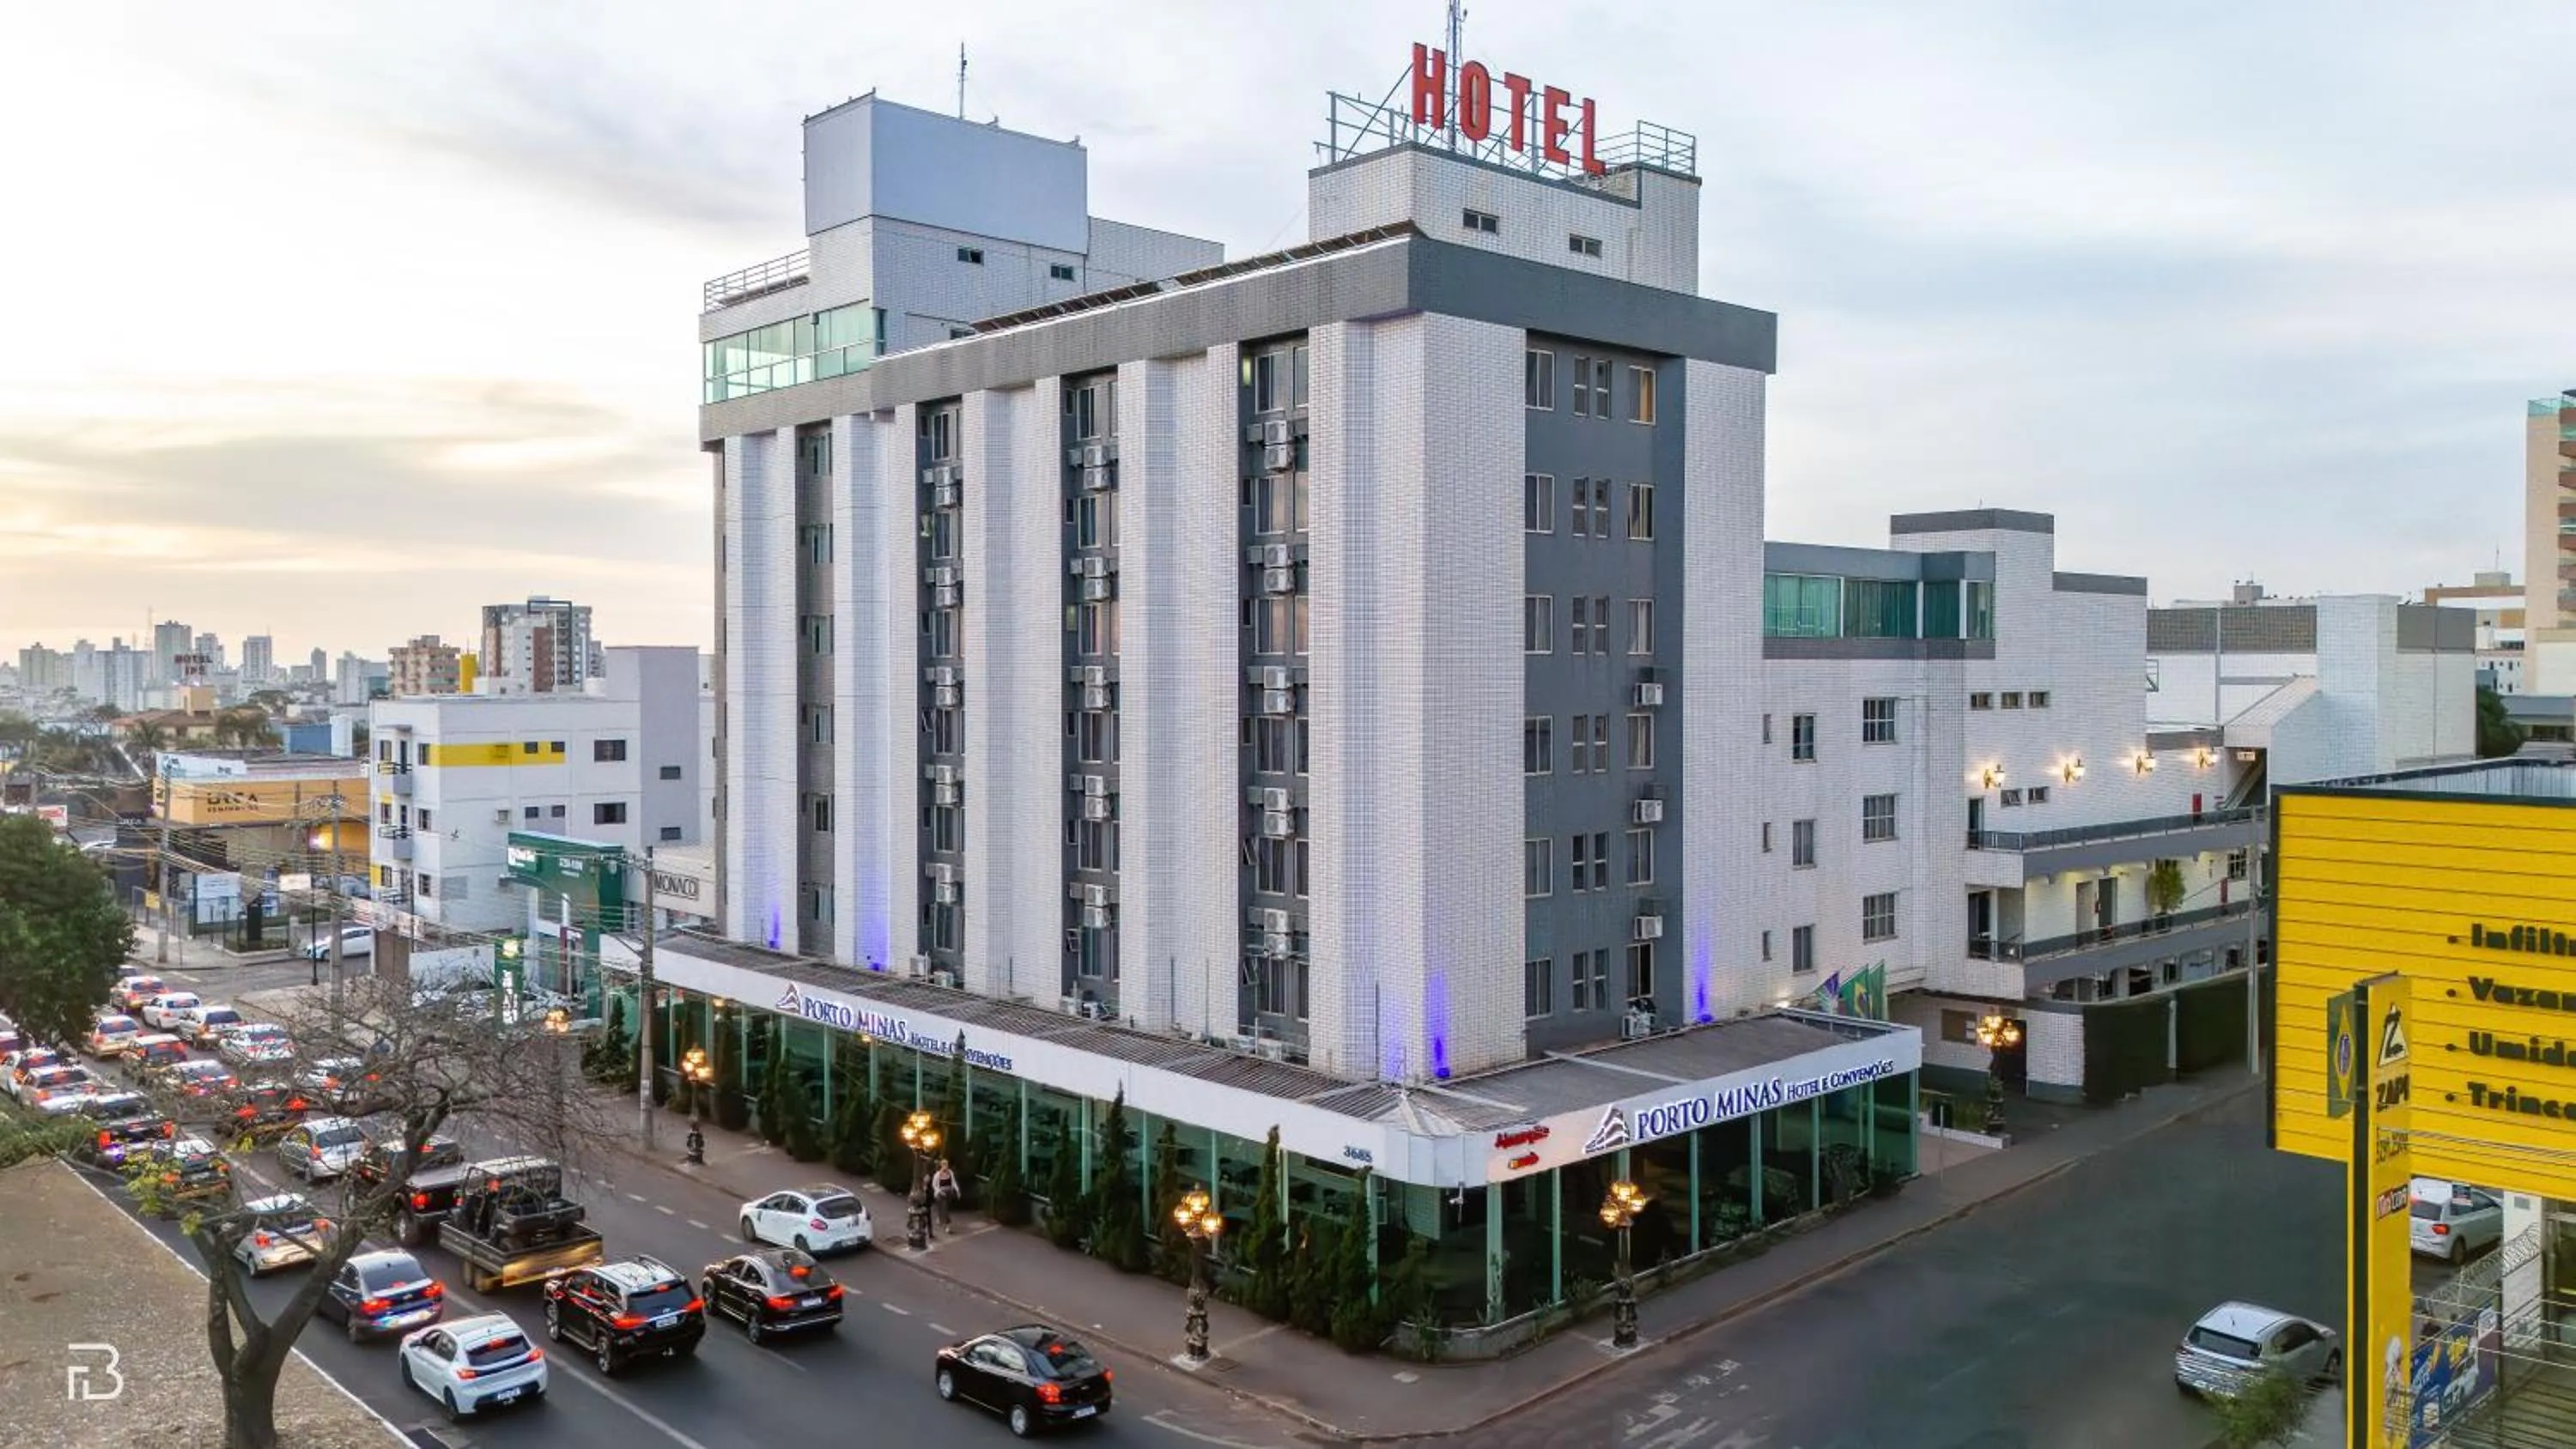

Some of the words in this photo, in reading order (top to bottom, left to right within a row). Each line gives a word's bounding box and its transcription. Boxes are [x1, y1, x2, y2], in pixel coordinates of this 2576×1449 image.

[1411, 41, 1606, 177] HOTEL
[805, 997, 851, 1028] PORTO
[858, 1009, 907, 1042] MINAS
[911, 1031, 939, 1052] HOTEL
[949, 1043, 1012, 1070] CNVENÇÕES
[1637, 1097, 1709, 1140] PORTO
[1715, 1078, 1781, 1119] MINAS
[1785, 1079, 1819, 1099] HOTEL
[1821, 1076, 1828, 1090] E
[1830, 1059, 1893, 1088] CONVENÇÕES
